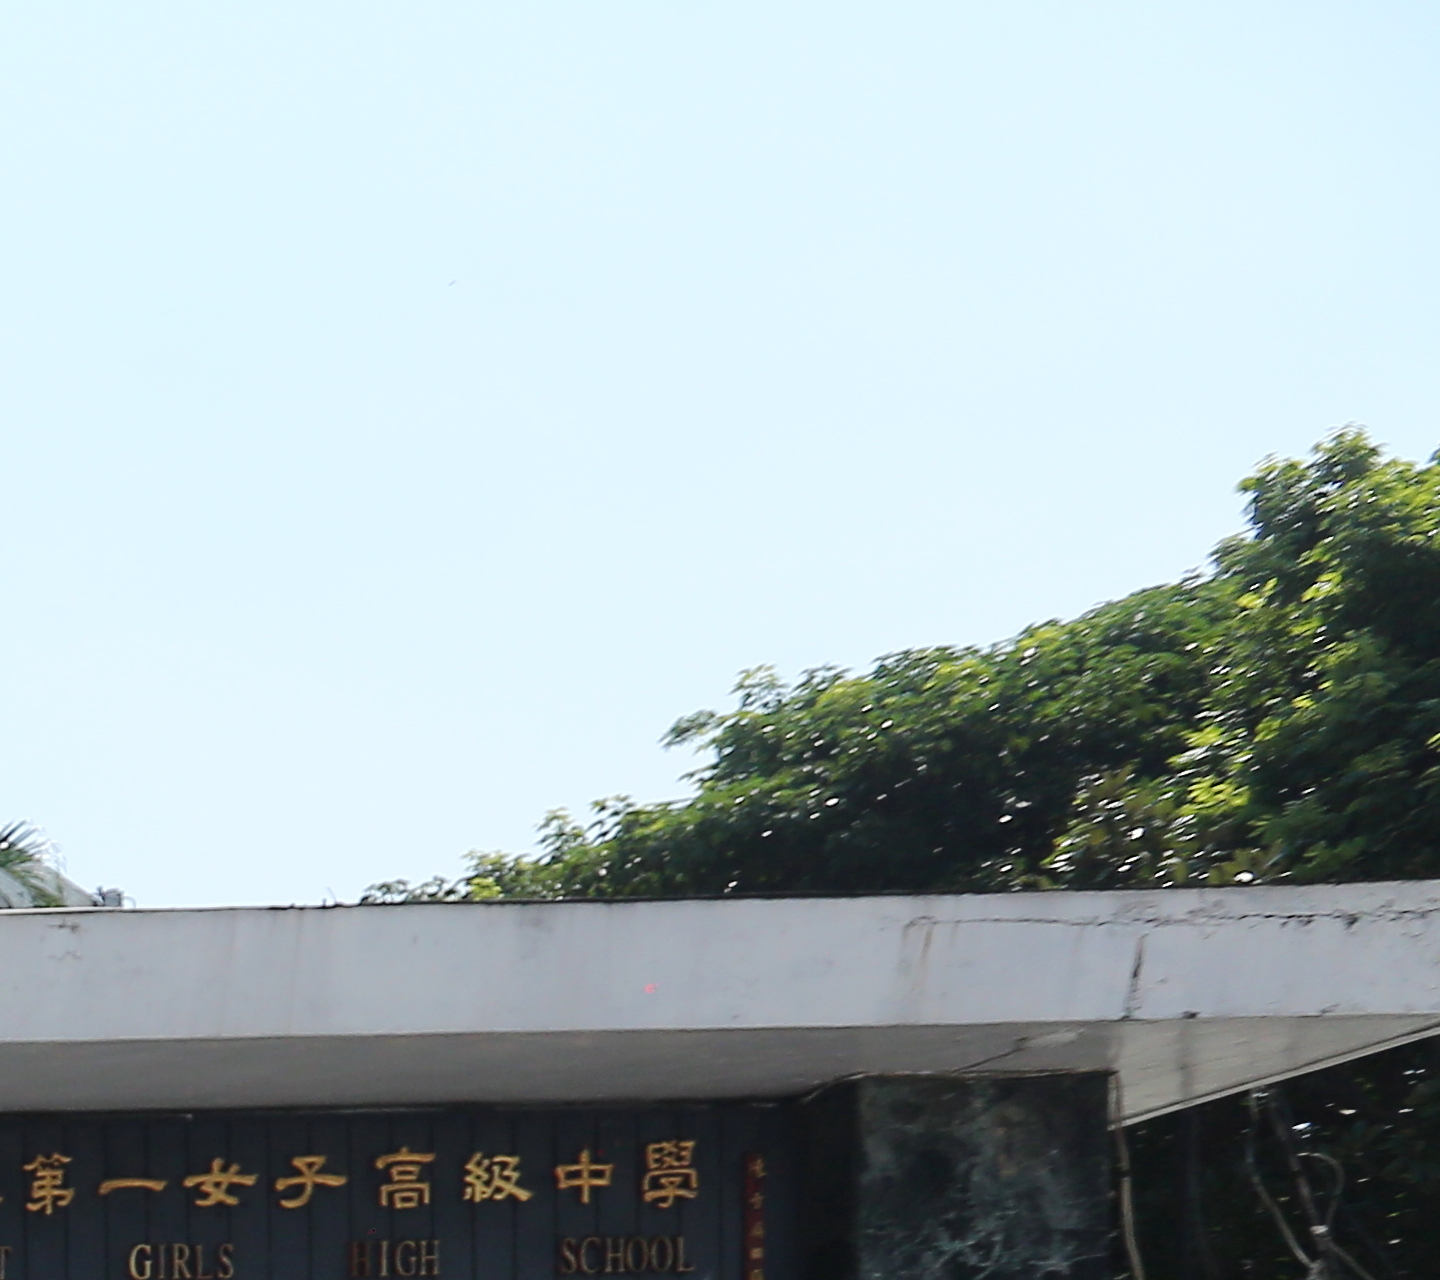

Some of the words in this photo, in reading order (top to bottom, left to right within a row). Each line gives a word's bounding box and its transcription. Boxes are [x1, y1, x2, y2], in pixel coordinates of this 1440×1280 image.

[128, 1243, 235, 1280] GIRLS
[350, 1238, 441, 1278] HIGH
[559, 1236, 695, 1275] SCHOOL
